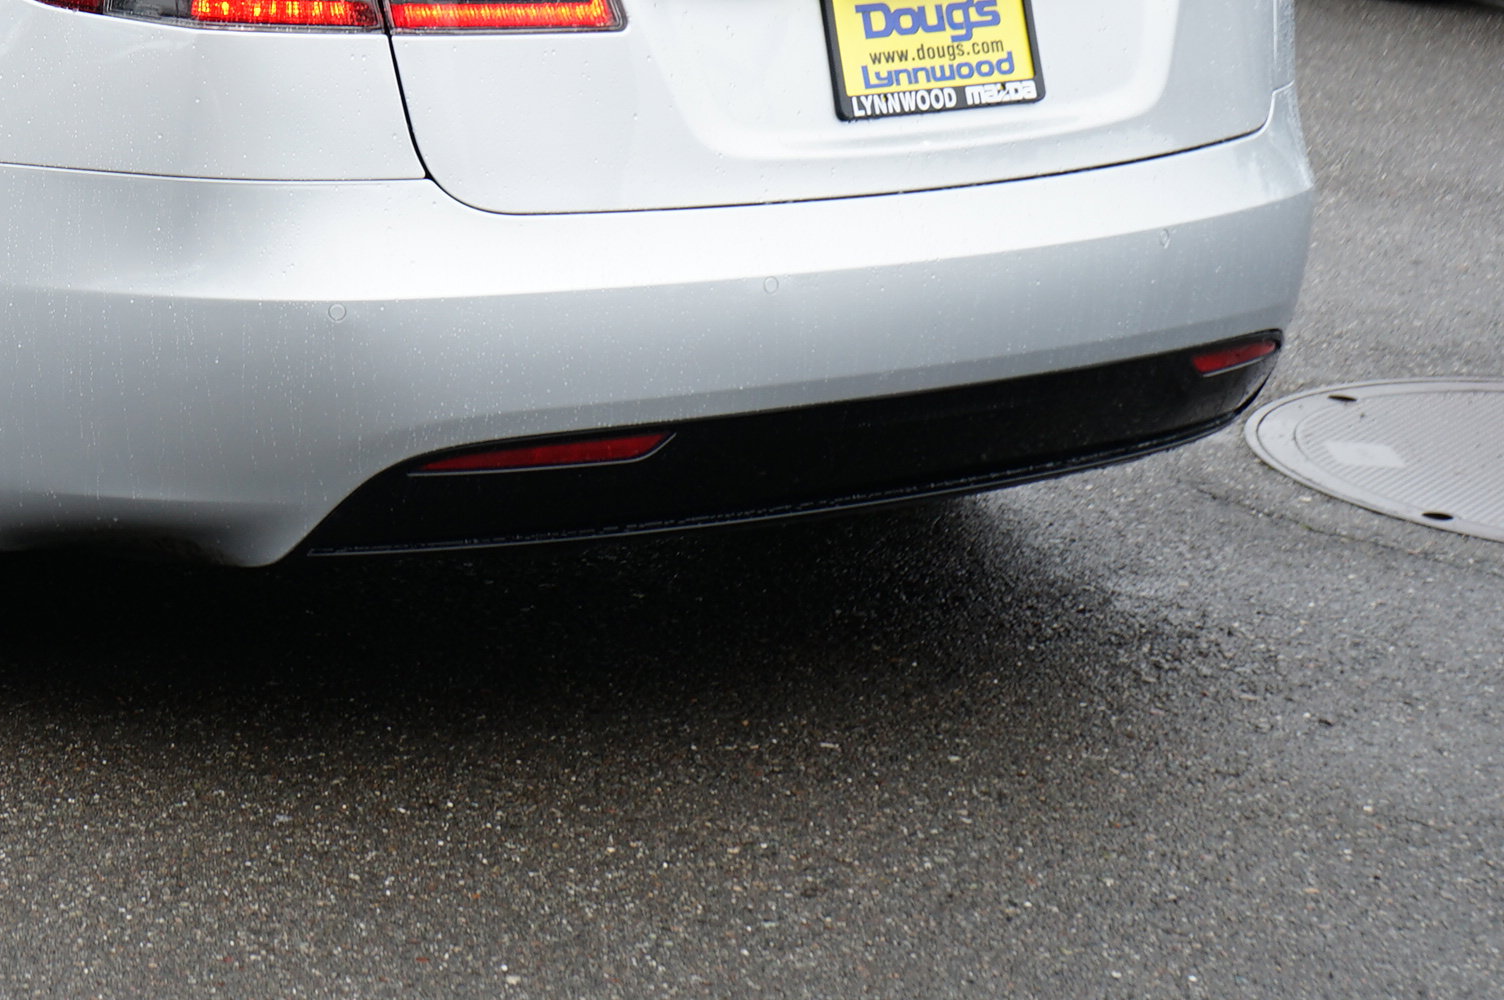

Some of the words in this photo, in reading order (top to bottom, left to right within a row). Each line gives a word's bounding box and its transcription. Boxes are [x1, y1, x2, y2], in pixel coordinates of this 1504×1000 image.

[869, 39, 1004, 65] www.dougs.com
[861, 51, 1015, 89] Lynnwood
[852, 87, 957, 117] LYNNWOOD
